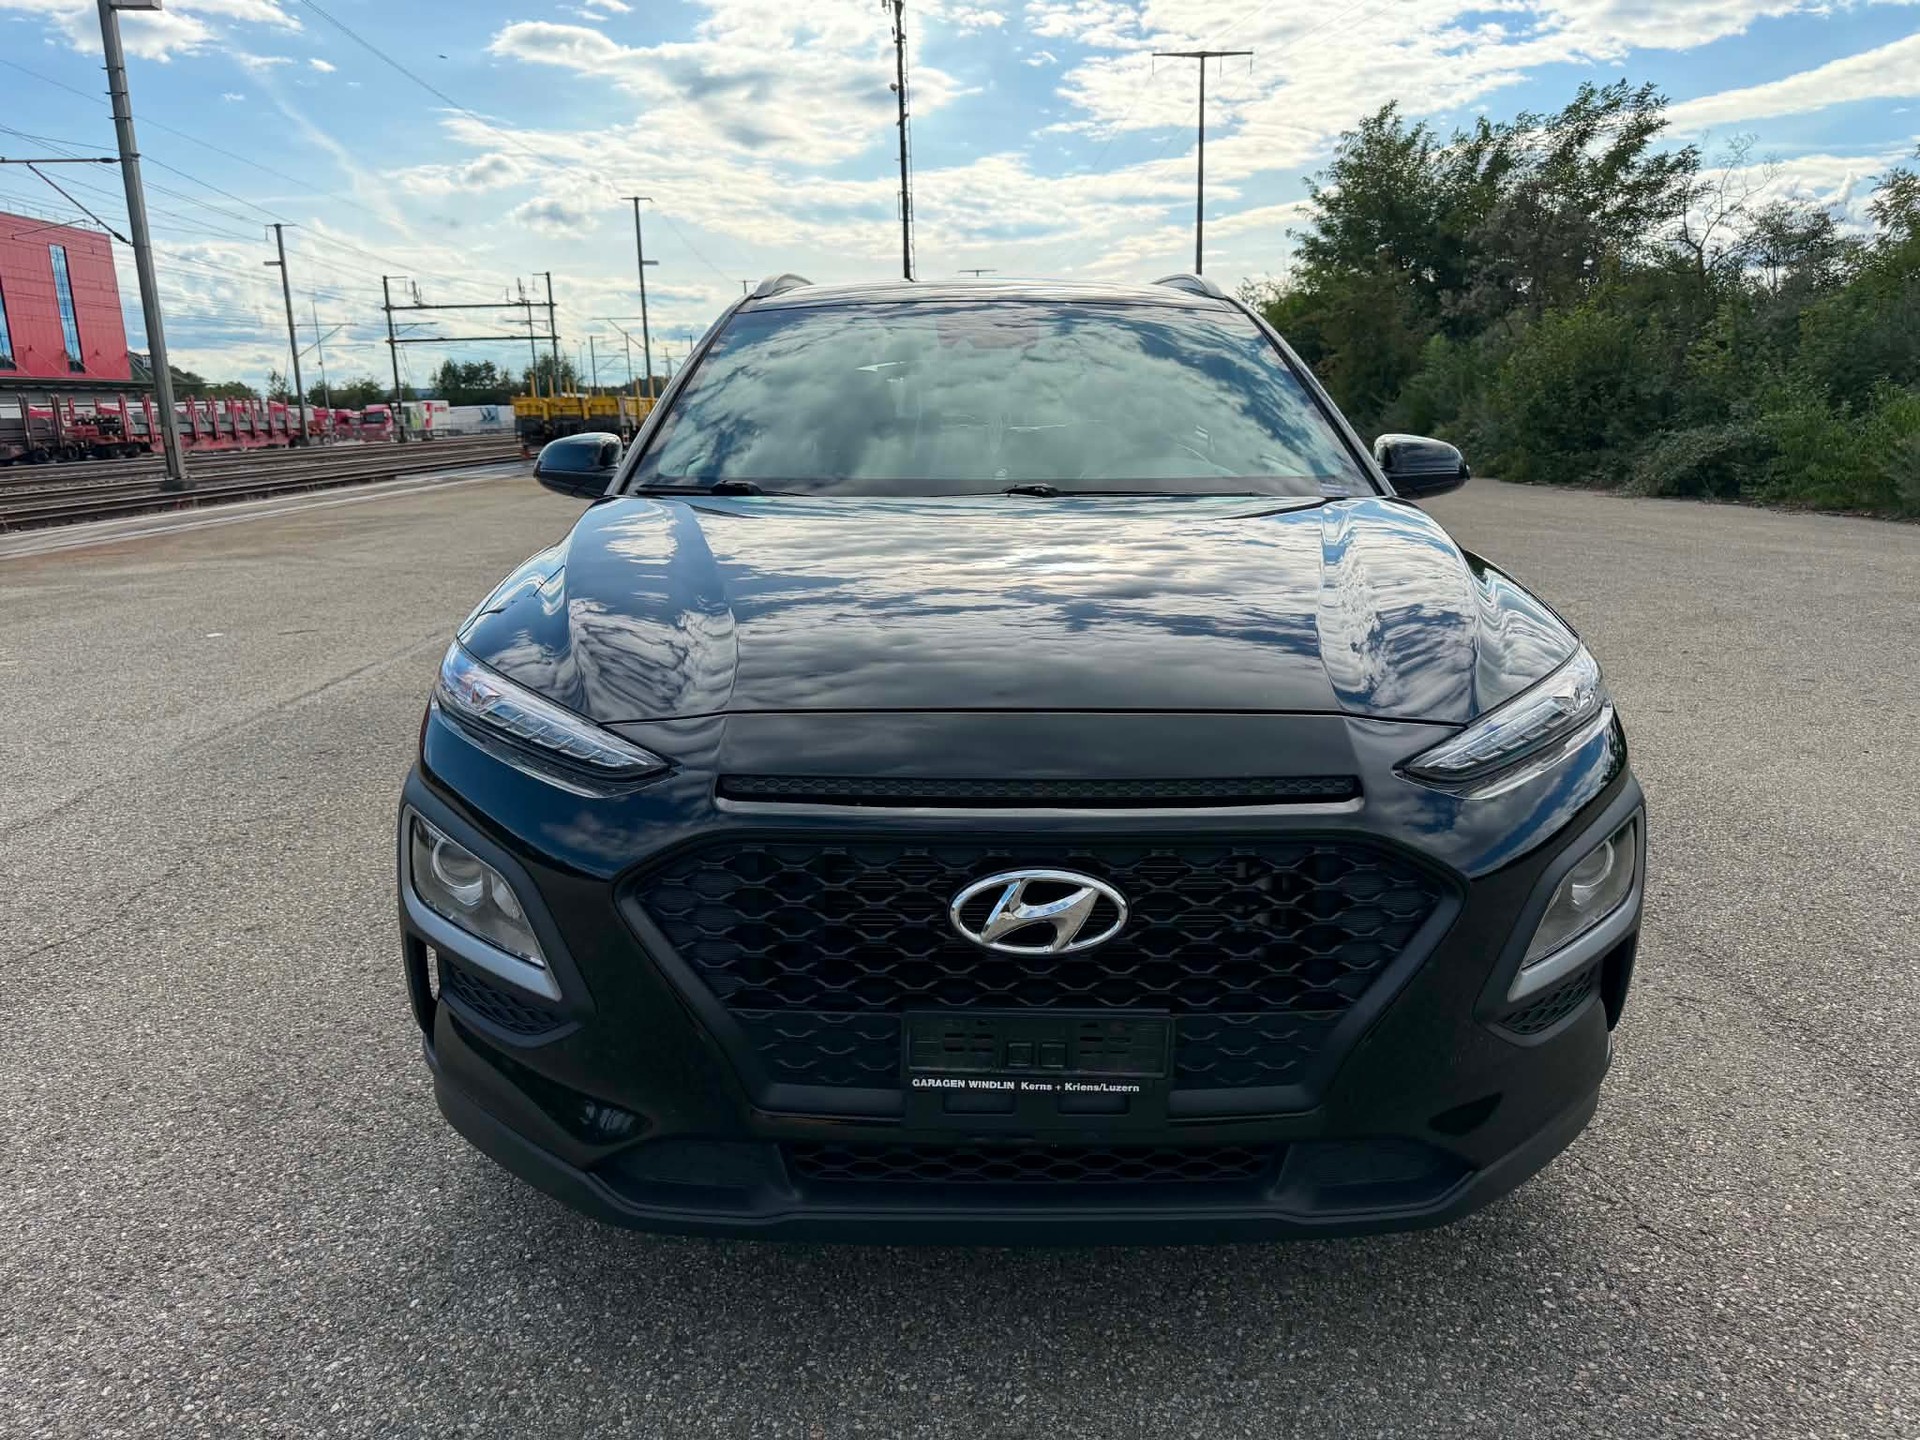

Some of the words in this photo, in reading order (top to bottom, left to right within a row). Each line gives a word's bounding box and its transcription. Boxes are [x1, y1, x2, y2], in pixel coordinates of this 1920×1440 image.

[911, 1078, 966, 1089] GARAGEN
[967, 1079, 1015, 1090] WINDLIN
[1020, 1081, 1053, 1091] Kerns
[1064, 1082, 1140, 1092] Kriens/Luzern
